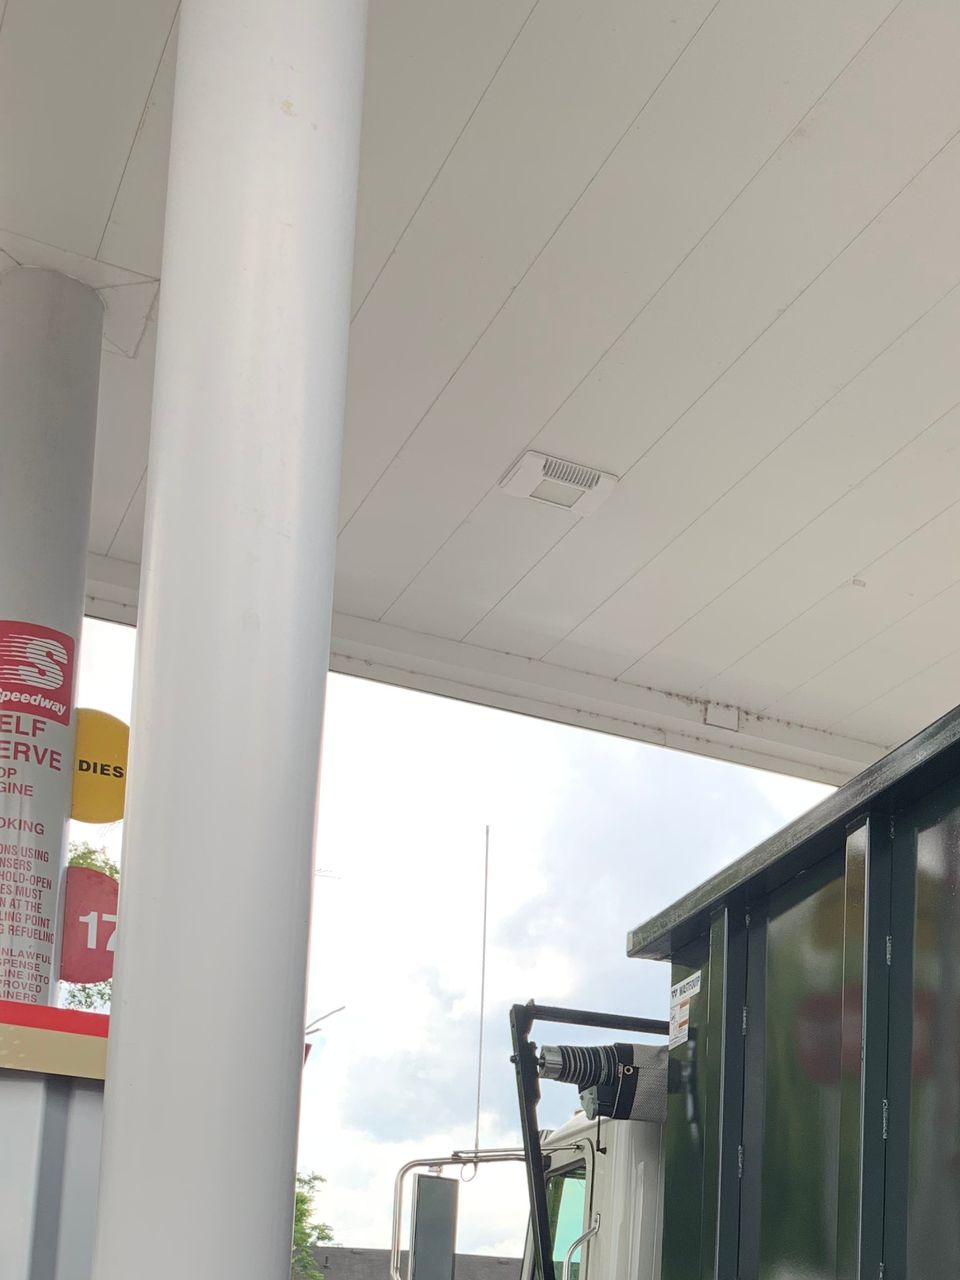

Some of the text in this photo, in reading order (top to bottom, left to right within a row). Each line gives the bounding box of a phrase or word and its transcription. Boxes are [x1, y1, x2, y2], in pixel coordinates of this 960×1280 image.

[0, 687, 66, 716] peedway
[78, 759, 124, 778] DIES
[21, 847, 49, 863] USING
[15, 886, 43, 901] MUST
[10, 898, 22, 911] AT
[24, 900, 42, 914] THE
[25, 913, 51, 929] POINT
[0, 979, 42, 993] ROVED
[27, 972, 50, 985] INTO
[0, 990, 37, 1003] INERS
